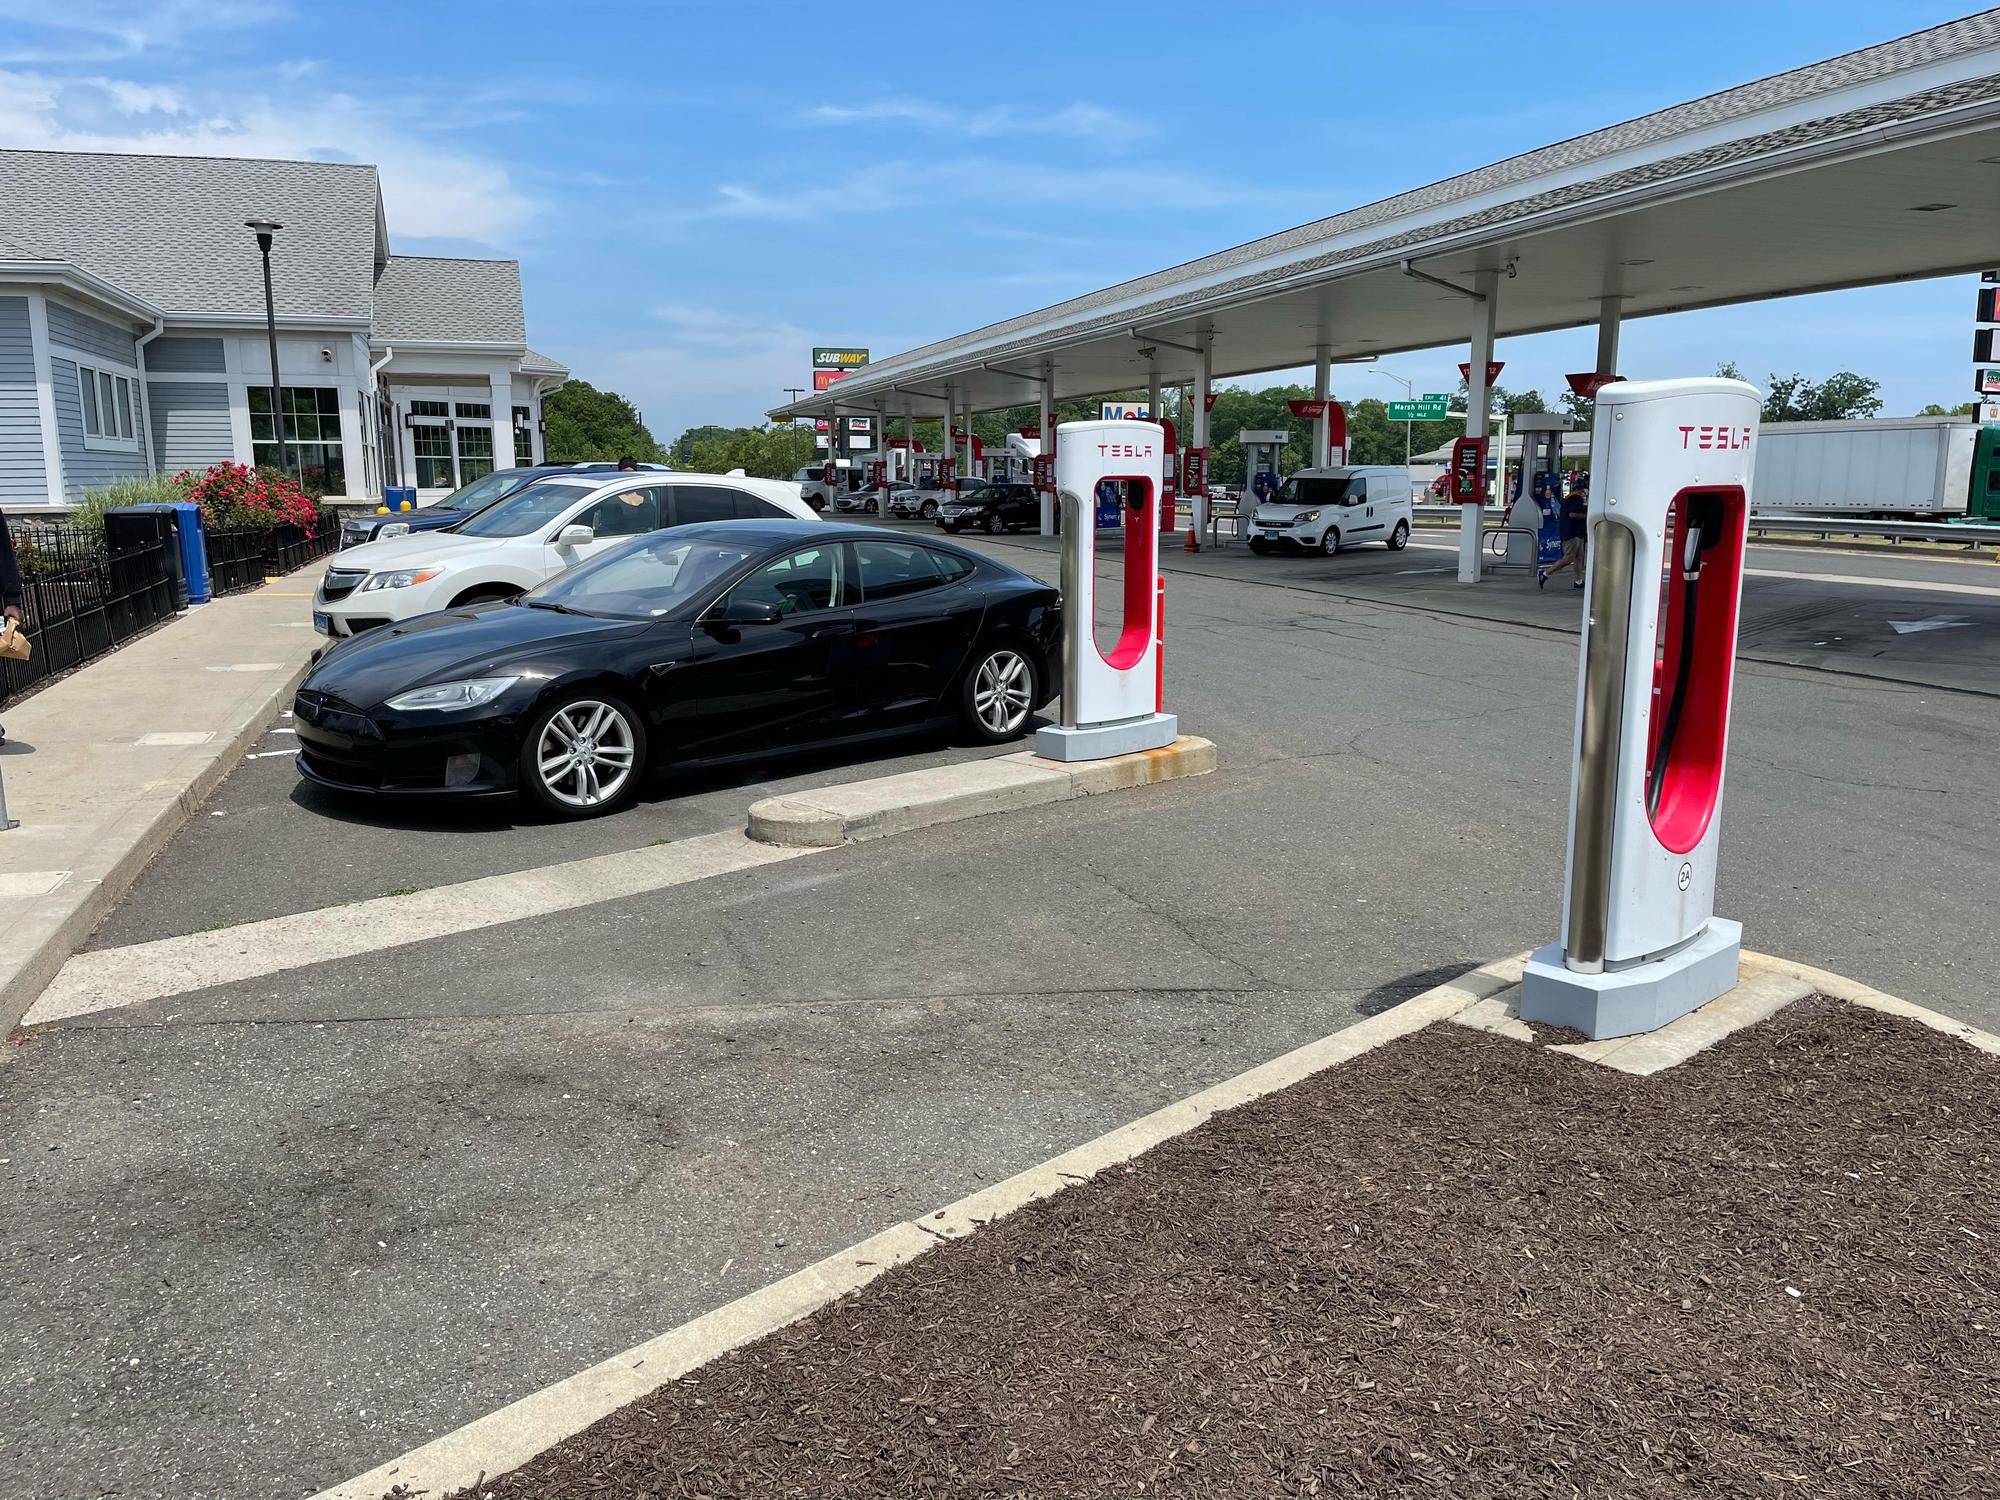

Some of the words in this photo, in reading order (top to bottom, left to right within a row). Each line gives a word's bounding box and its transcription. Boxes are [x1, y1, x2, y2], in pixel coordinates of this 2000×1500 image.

[816, 352, 867, 363] SUBWAY
[1489, 367, 1497, 375] 12
[1104, 406, 1150, 420] Mob
[1678, 426, 1751, 450] TESLA
[1097, 444, 1152, 458] TESLA
[1680, 870, 1690, 883] 2A
